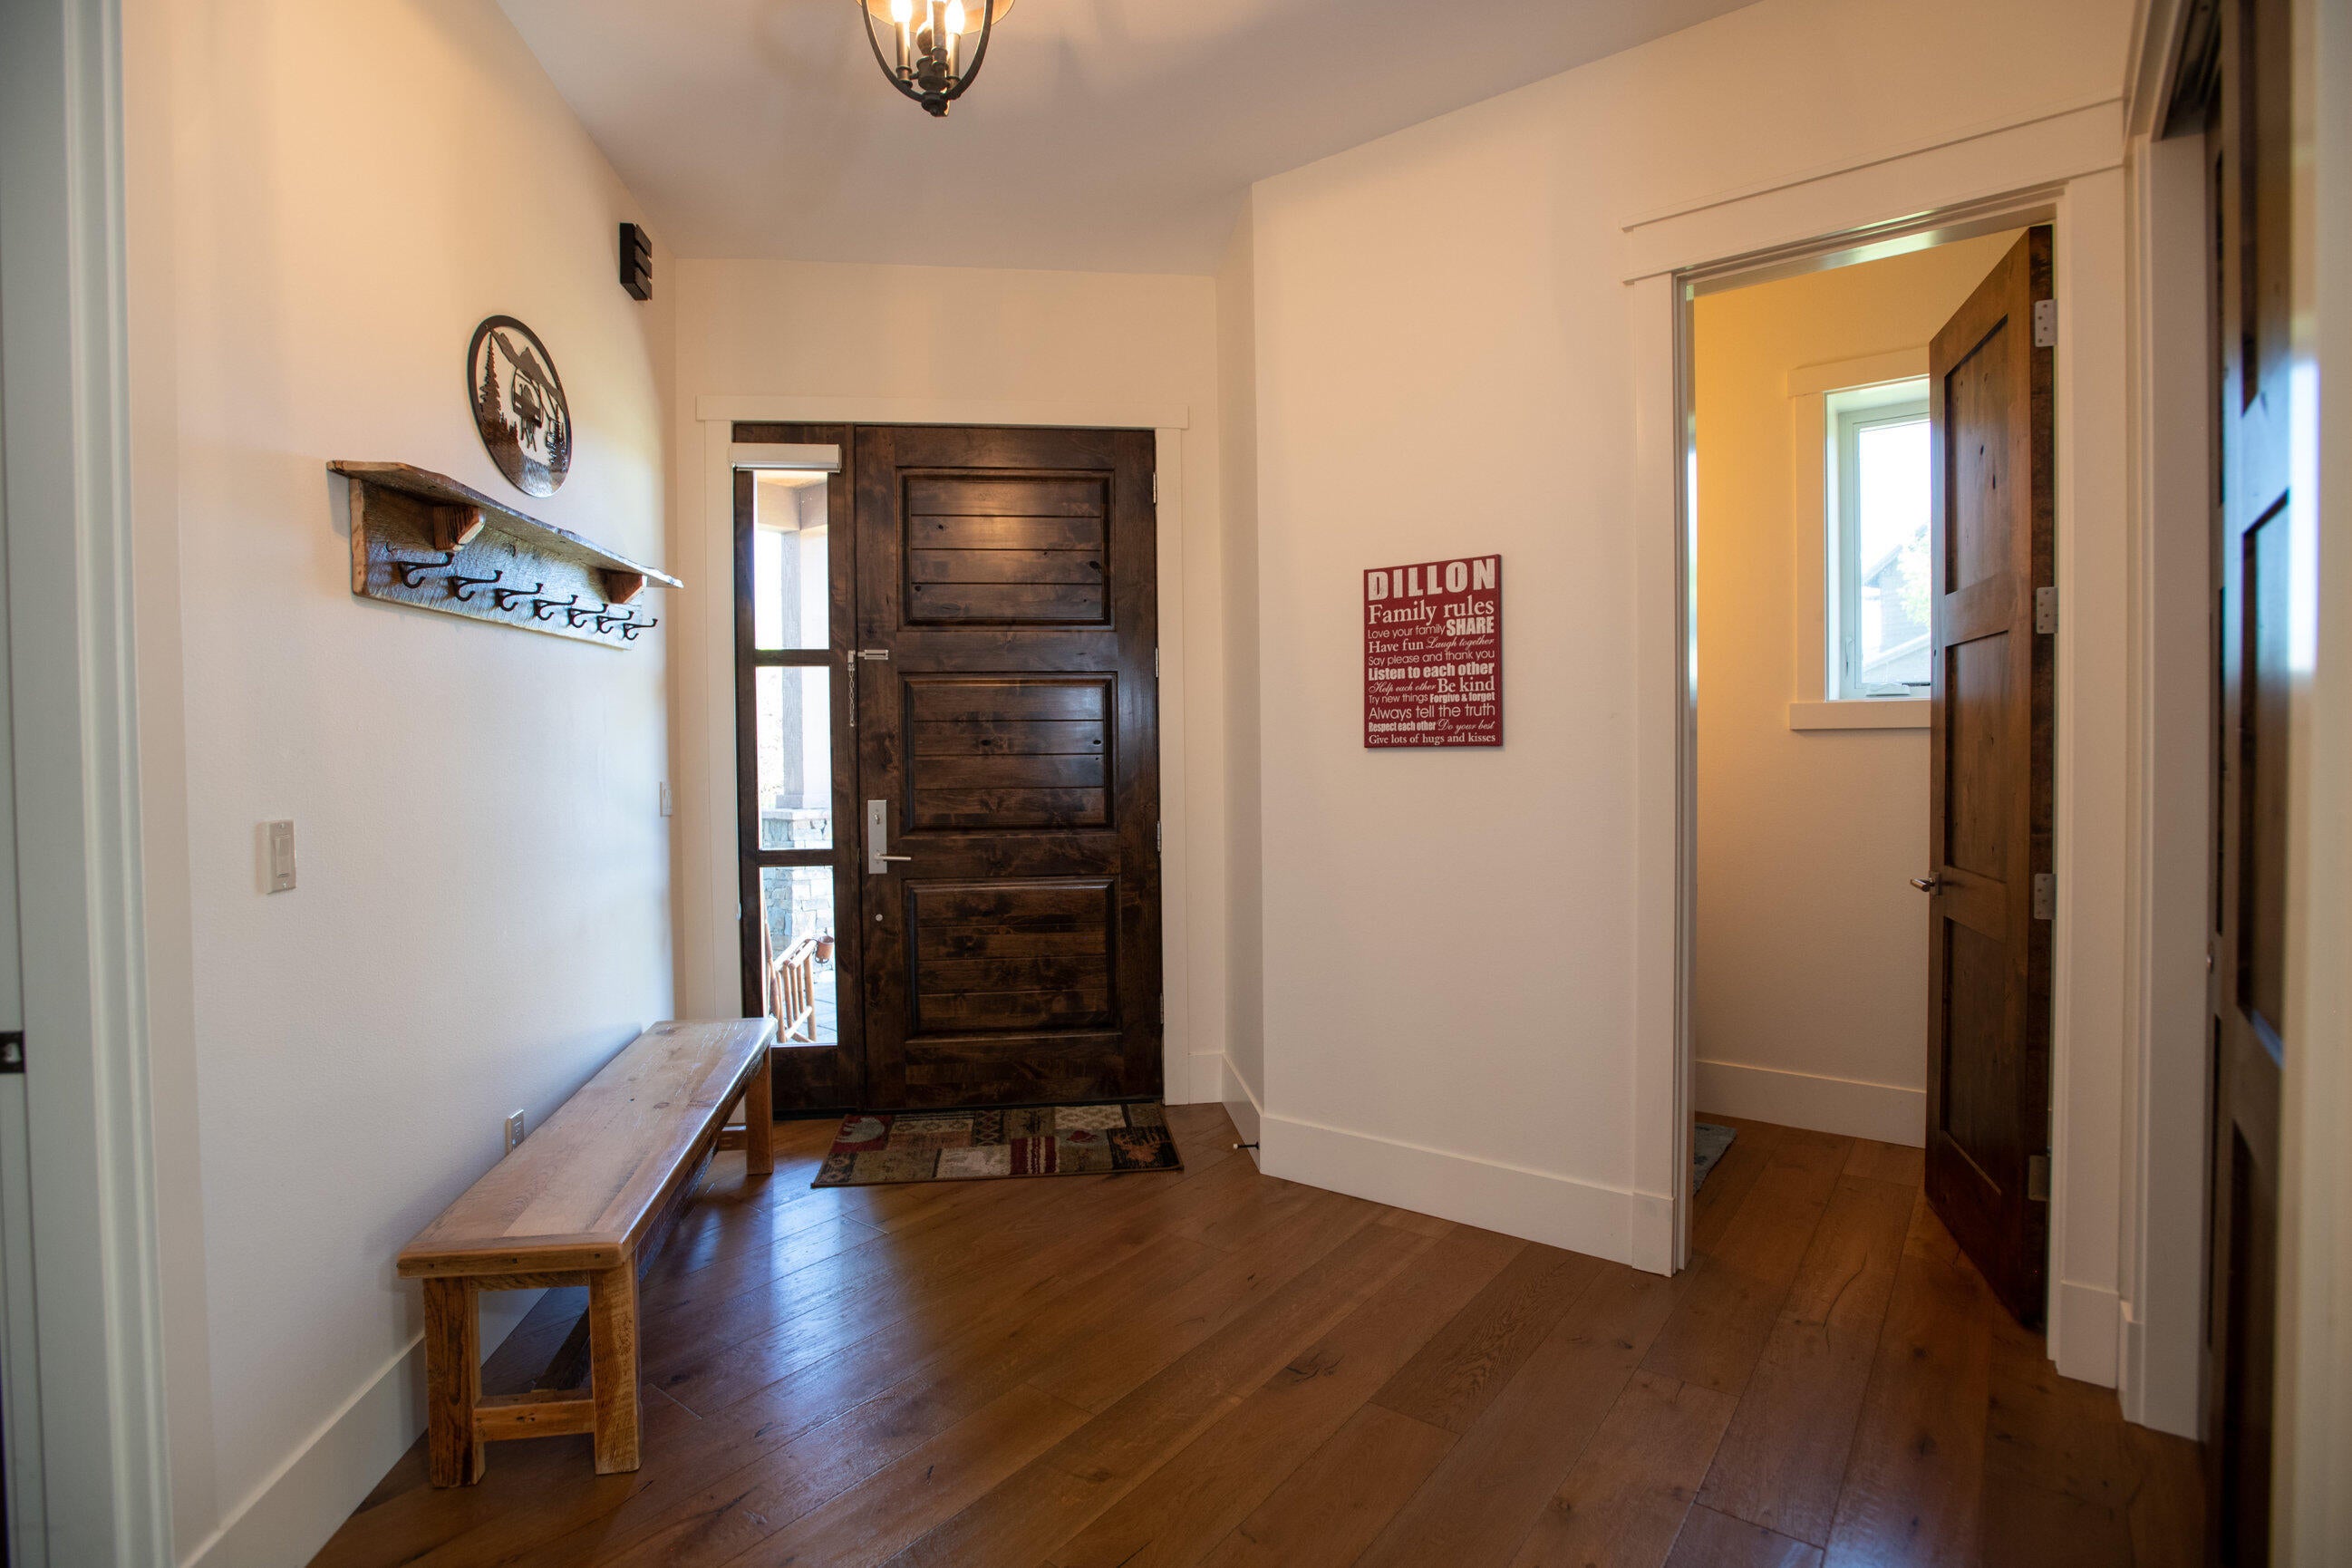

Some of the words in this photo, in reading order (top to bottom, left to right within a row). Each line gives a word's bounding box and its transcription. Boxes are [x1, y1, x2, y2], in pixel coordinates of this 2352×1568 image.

[1367, 558, 1495, 601] DILLON
[1368, 600, 1437, 625] Family
[1443, 595, 1494, 618] rules
[1368, 629, 1390, 639] Love
[1392, 628, 1413, 638] your
[1415, 624, 1445, 635] family
[1446, 616, 1494, 636] SHARE
[1369, 641, 1399, 653] Have
[1403, 639, 1424, 650] fun
[1425, 636, 1457, 651] Laugh
[1459, 635, 1494, 650] together
[1368, 656, 1385, 666] Say
[1387, 655, 1419, 666] please
[1422, 652, 1442, 662] and
[1445, 650, 1473, 660] thank
[1475, 650, 1495, 661] you
[1368, 667, 1405, 681] Listen
[1408, 666, 1420, 678] to
[1423, 663, 1455, 678] each
[1458, 661, 1495, 676] other
[1368, 681, 1393, 696] Help
[1395, 683, 1413, 692] each
[1415, 681, 1436, 691] other
[1437, 678, 1456, 693] Be
[1459, 676, 1495, 692] kind
[1368, 695, 1379, 705] Try
[1402, 693, 1428, 704] things
[1430, 694, 1460, 704] Forgive
[1461, 693, 1468, 702] &
[1469, 692, 1495, 702] forget
[1368, 707, 1412, 721] Always
[1416, 705, 1434, 717] tell
[1438, 705, 1461, 717] the
[1465, 703, 1495, 717] truth
[1368, 722, 1397, 733] Respect
[1398, 722, 1415, 731] each
[1416, 721, 1436, 731] other
[1454, 723, 1476, 734] your
[1368, 735, 1389, 744] Give
[1391, 734, 1407, 743] lots
[1410, 734, 1419, 743] of
[1422, 733, 1444, 745] hugs
[1447, 733, 1465, 742] and
[1468, 733, 1495, 742] kisses
